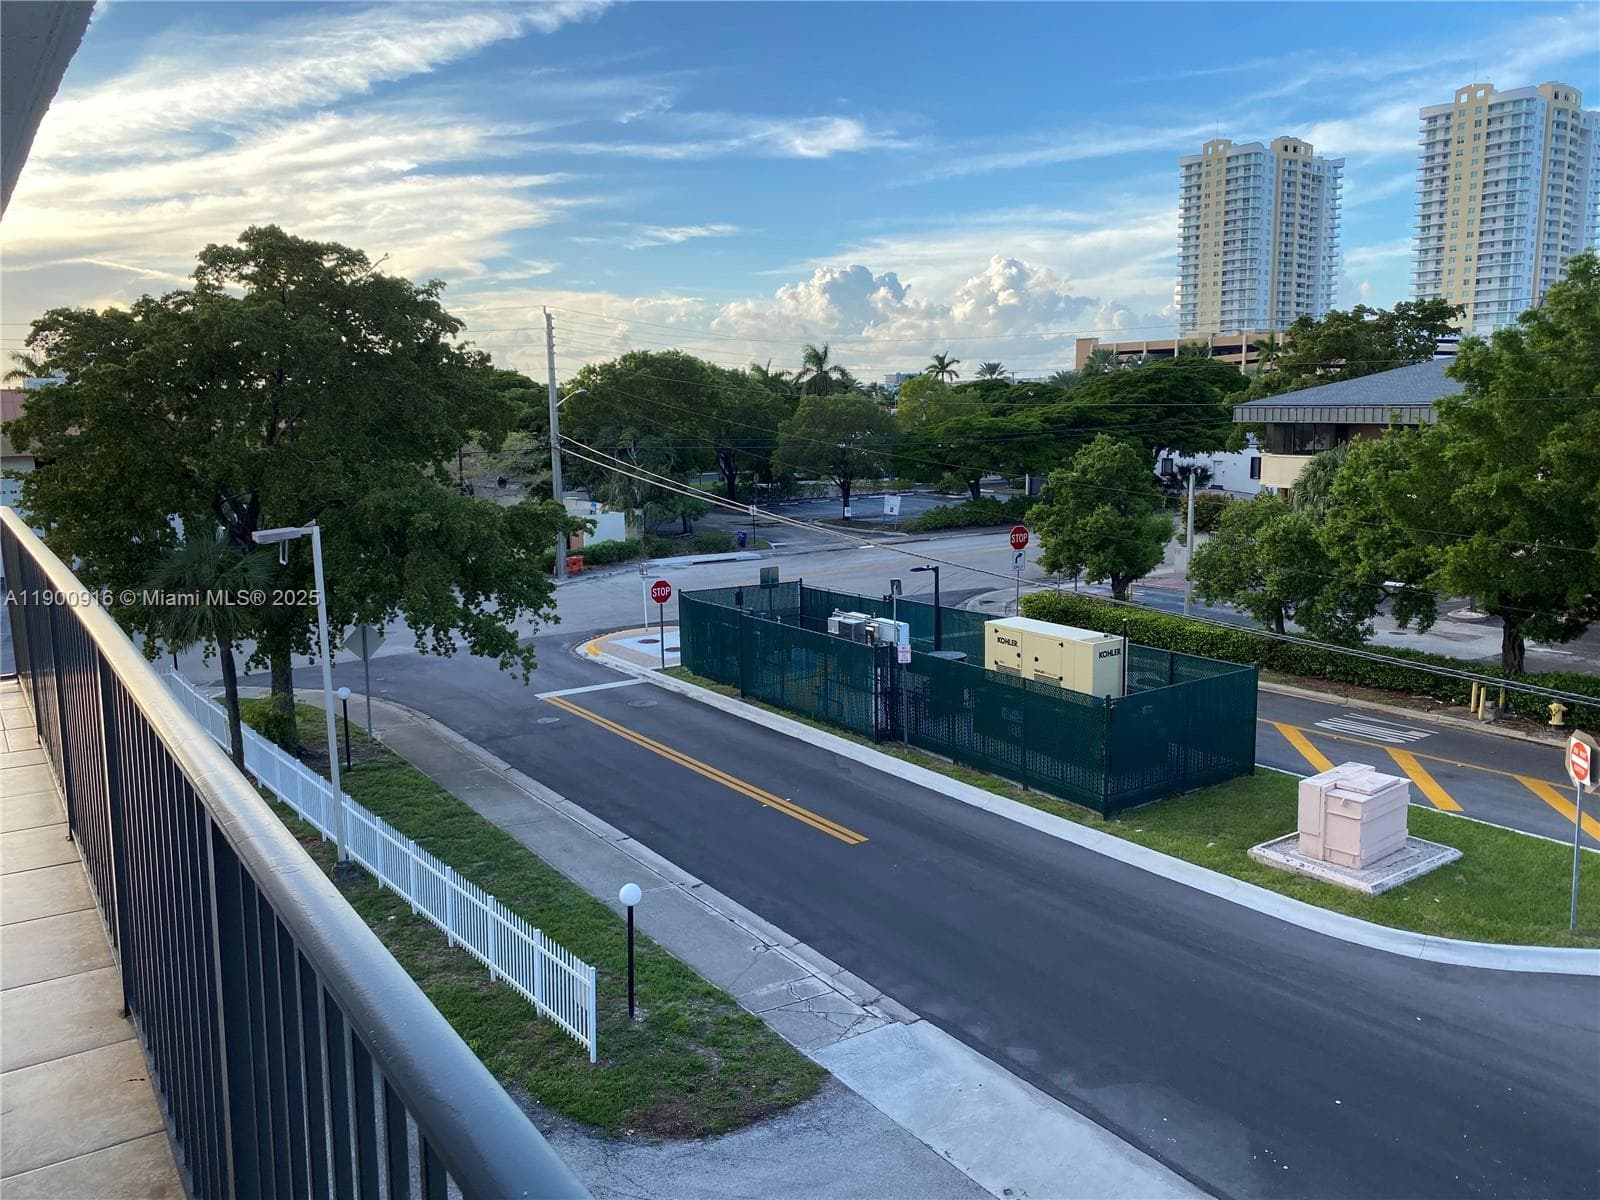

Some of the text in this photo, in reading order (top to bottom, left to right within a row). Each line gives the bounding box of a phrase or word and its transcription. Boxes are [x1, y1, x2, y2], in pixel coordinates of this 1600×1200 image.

[1011, 533, 1028, 544] STOP
[652, 586, 671, 597] STOP
[997, 636, 1018, 648] KOHLER
[1098, 648, 1121, 659] KOHLER
[1313, 712, 1440, 744] ONLY
